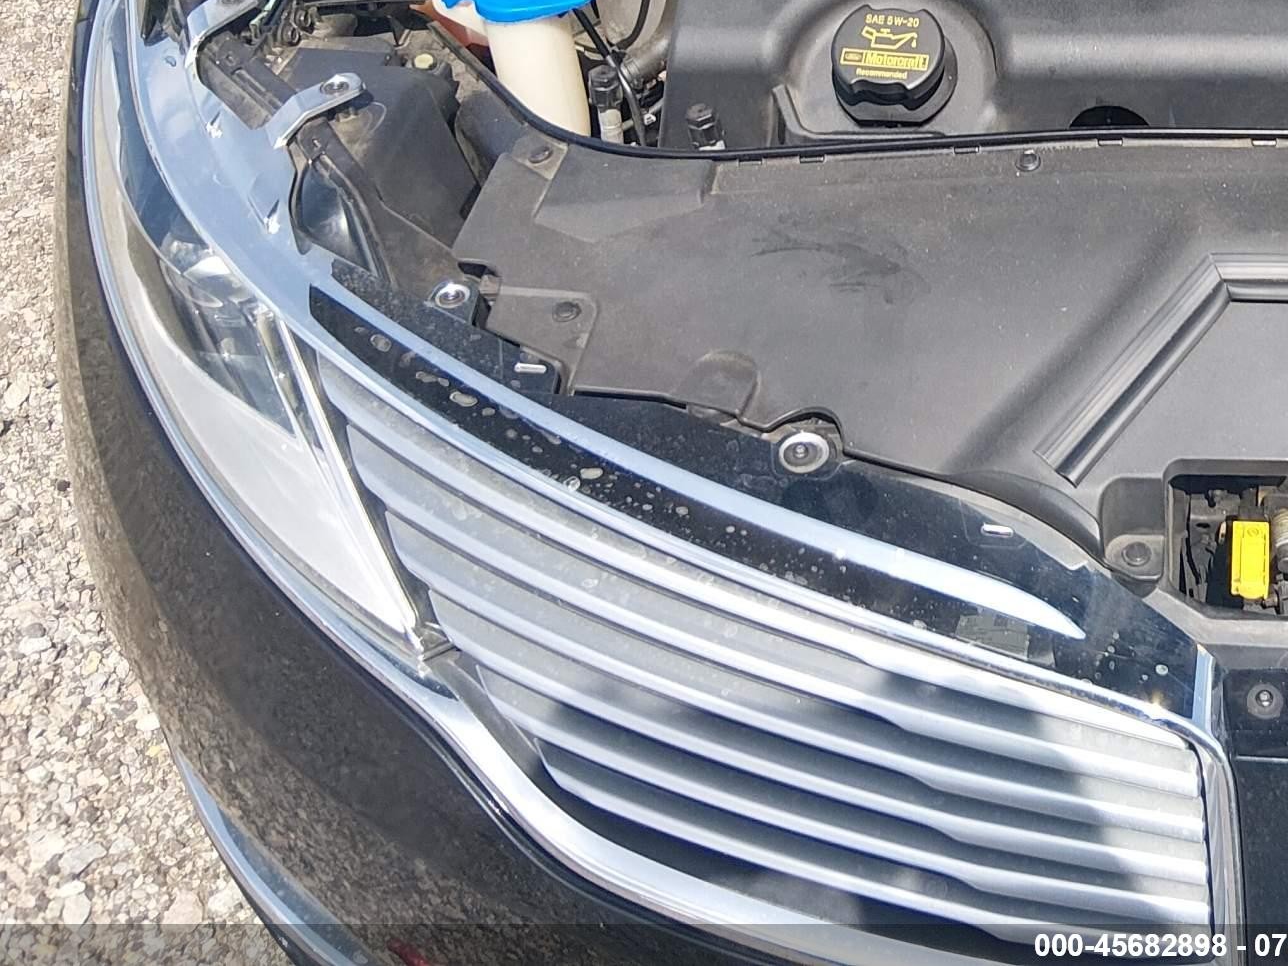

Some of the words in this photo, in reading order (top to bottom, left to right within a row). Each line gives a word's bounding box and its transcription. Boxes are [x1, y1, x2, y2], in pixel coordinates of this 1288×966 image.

[865, 14, 885, 25] SAE
[887, 15, 920, 28] 5W-20
[865, 51, 923, 68] Motorcraft
[856, 68, 908, 79] Recommended
